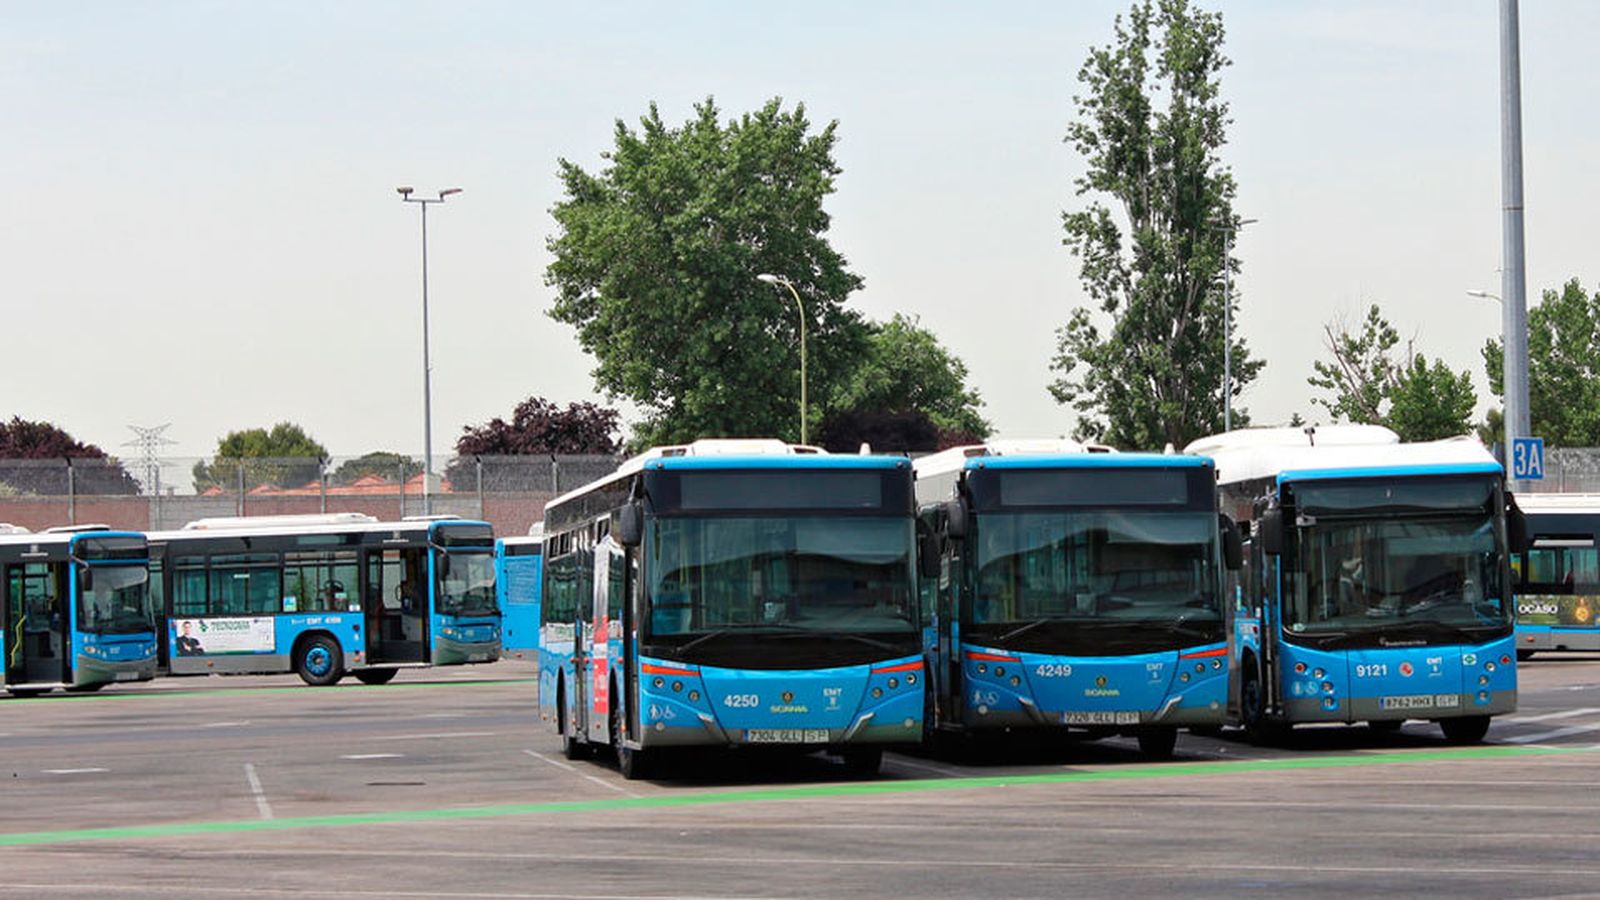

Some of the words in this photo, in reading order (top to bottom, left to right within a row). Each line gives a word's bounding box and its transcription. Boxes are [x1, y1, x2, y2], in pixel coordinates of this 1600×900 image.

[1515, 442, 1541, 475] 3A
[1518, 604, 1558, 614] OCASO
[1036, 664, 1072, 676] 4249
[1356, 664, 1387, 677] 9121
[724, 694, 758, 707] 4250
[770, 705, 808, 713] SCANIA
